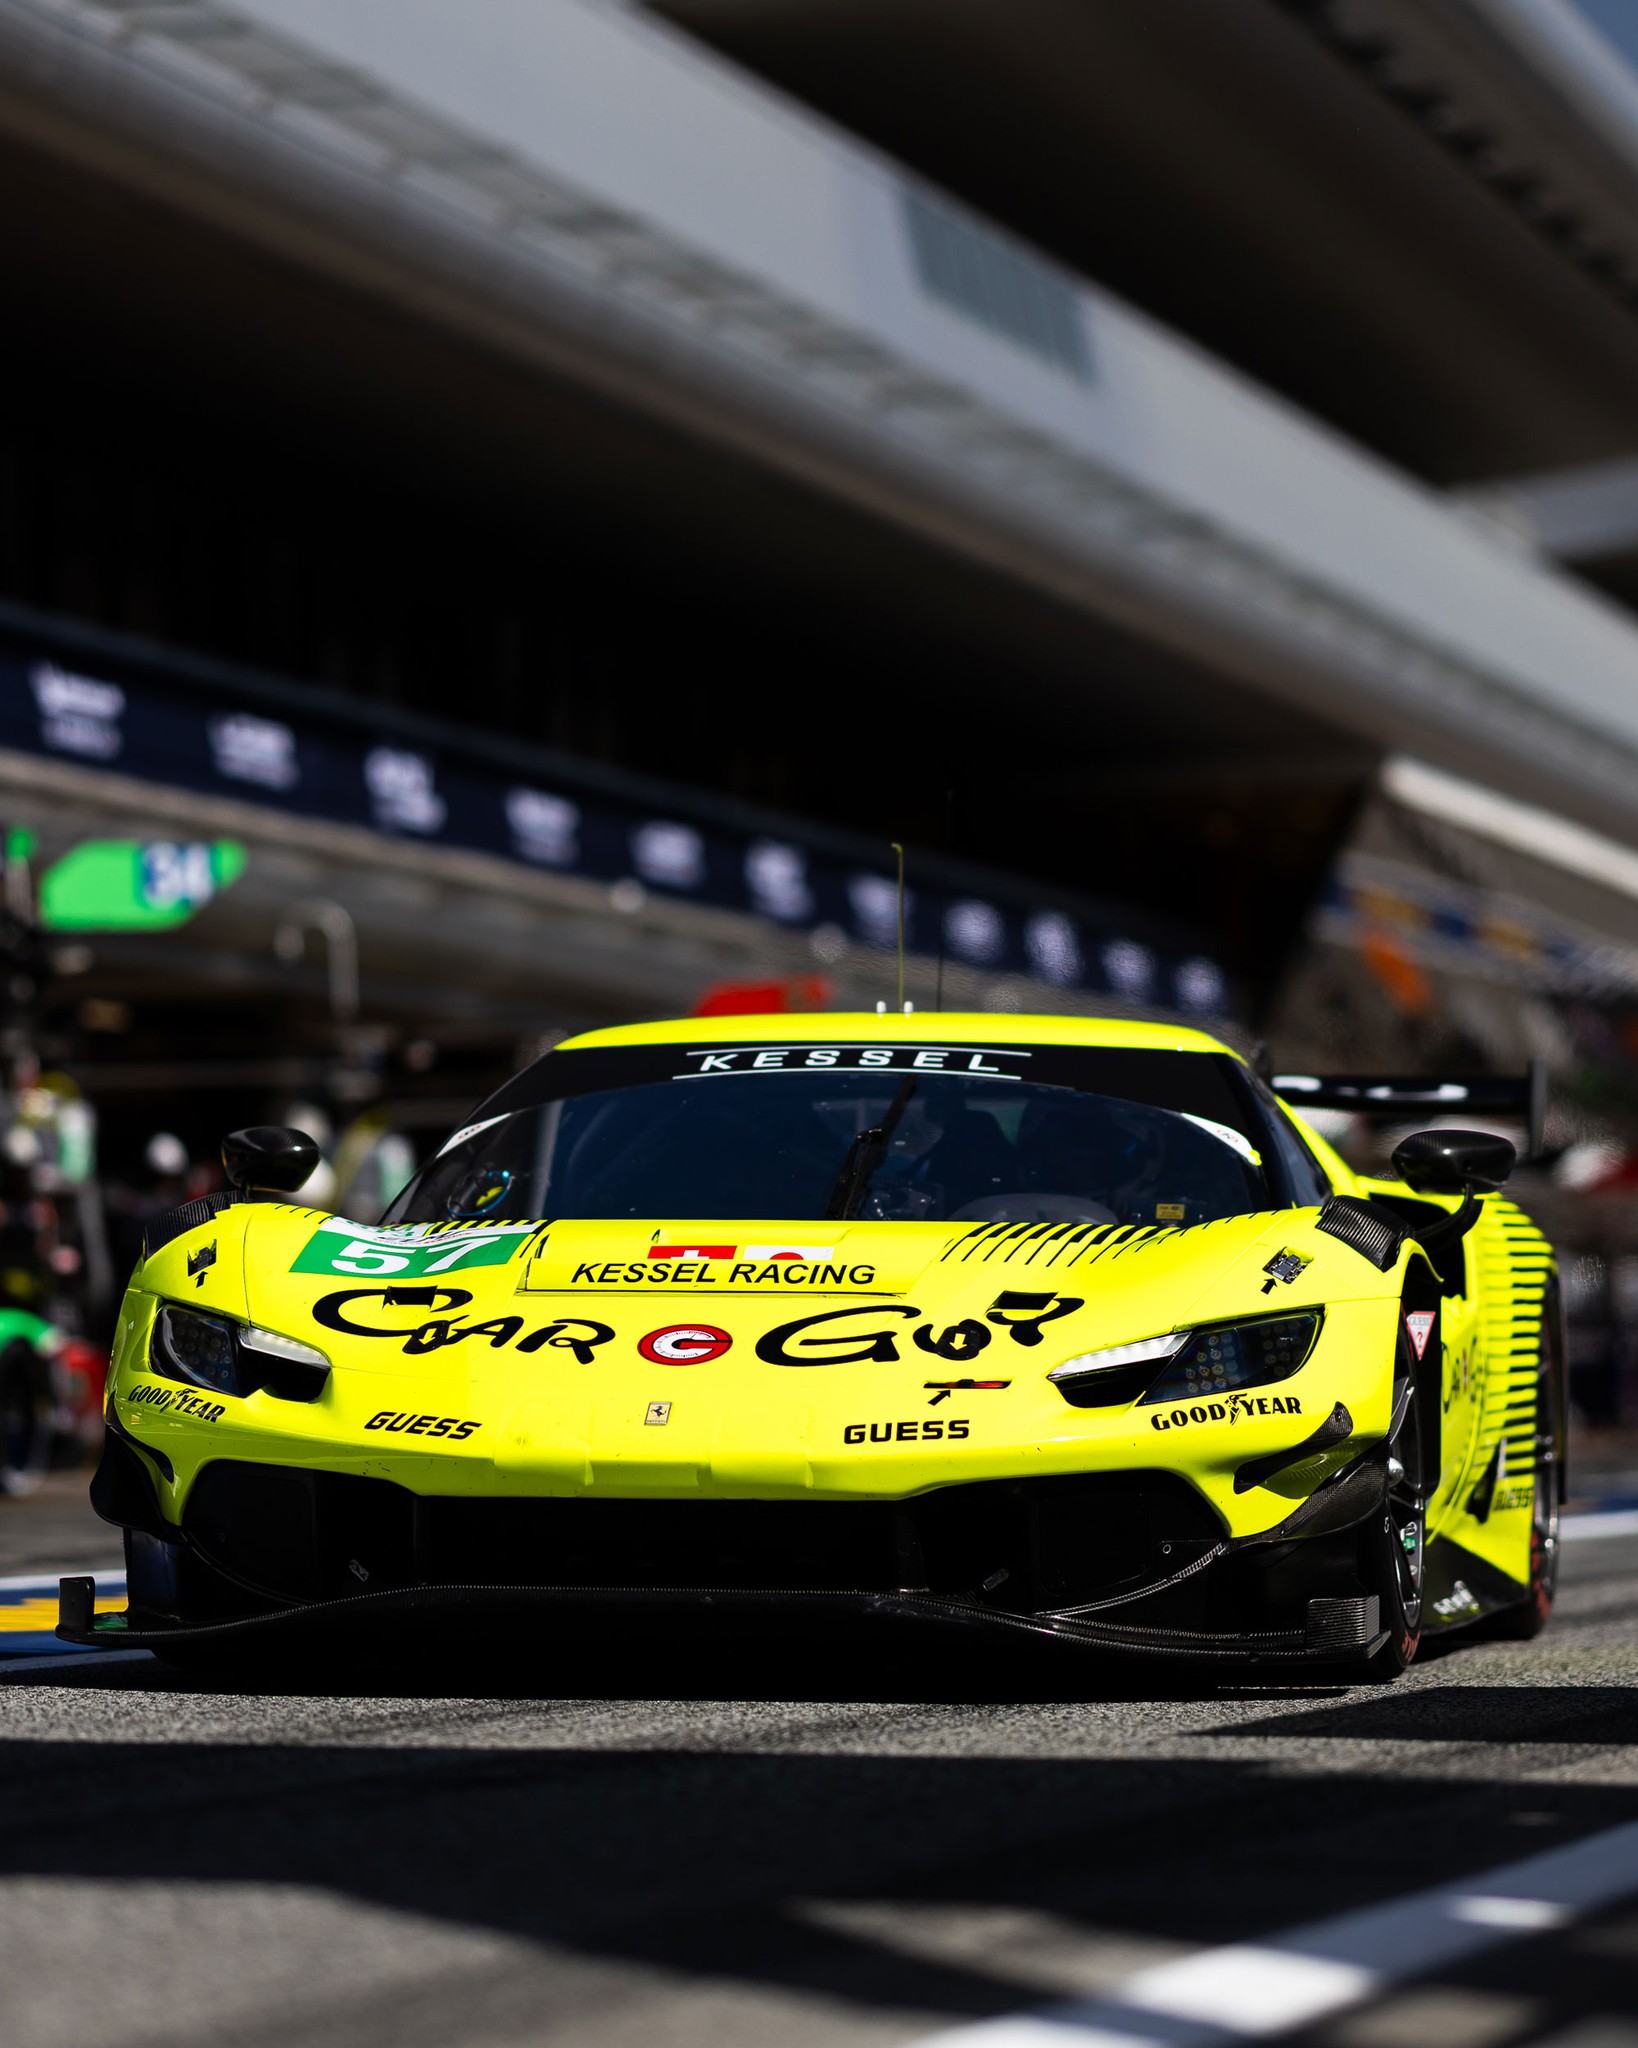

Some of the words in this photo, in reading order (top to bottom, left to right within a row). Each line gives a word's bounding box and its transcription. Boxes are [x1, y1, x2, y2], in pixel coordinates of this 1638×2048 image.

[700, 1050, 1001, 1073] KESSEL
[331, 1236, 502, 1275] 57
[571, 1262, 717, 1285] KESSEL
[728, 1263, 876, 1286] RACING
[364, 1411, 483, 1441] GUESS
[844, 1419, 970, 1445] GUESS
